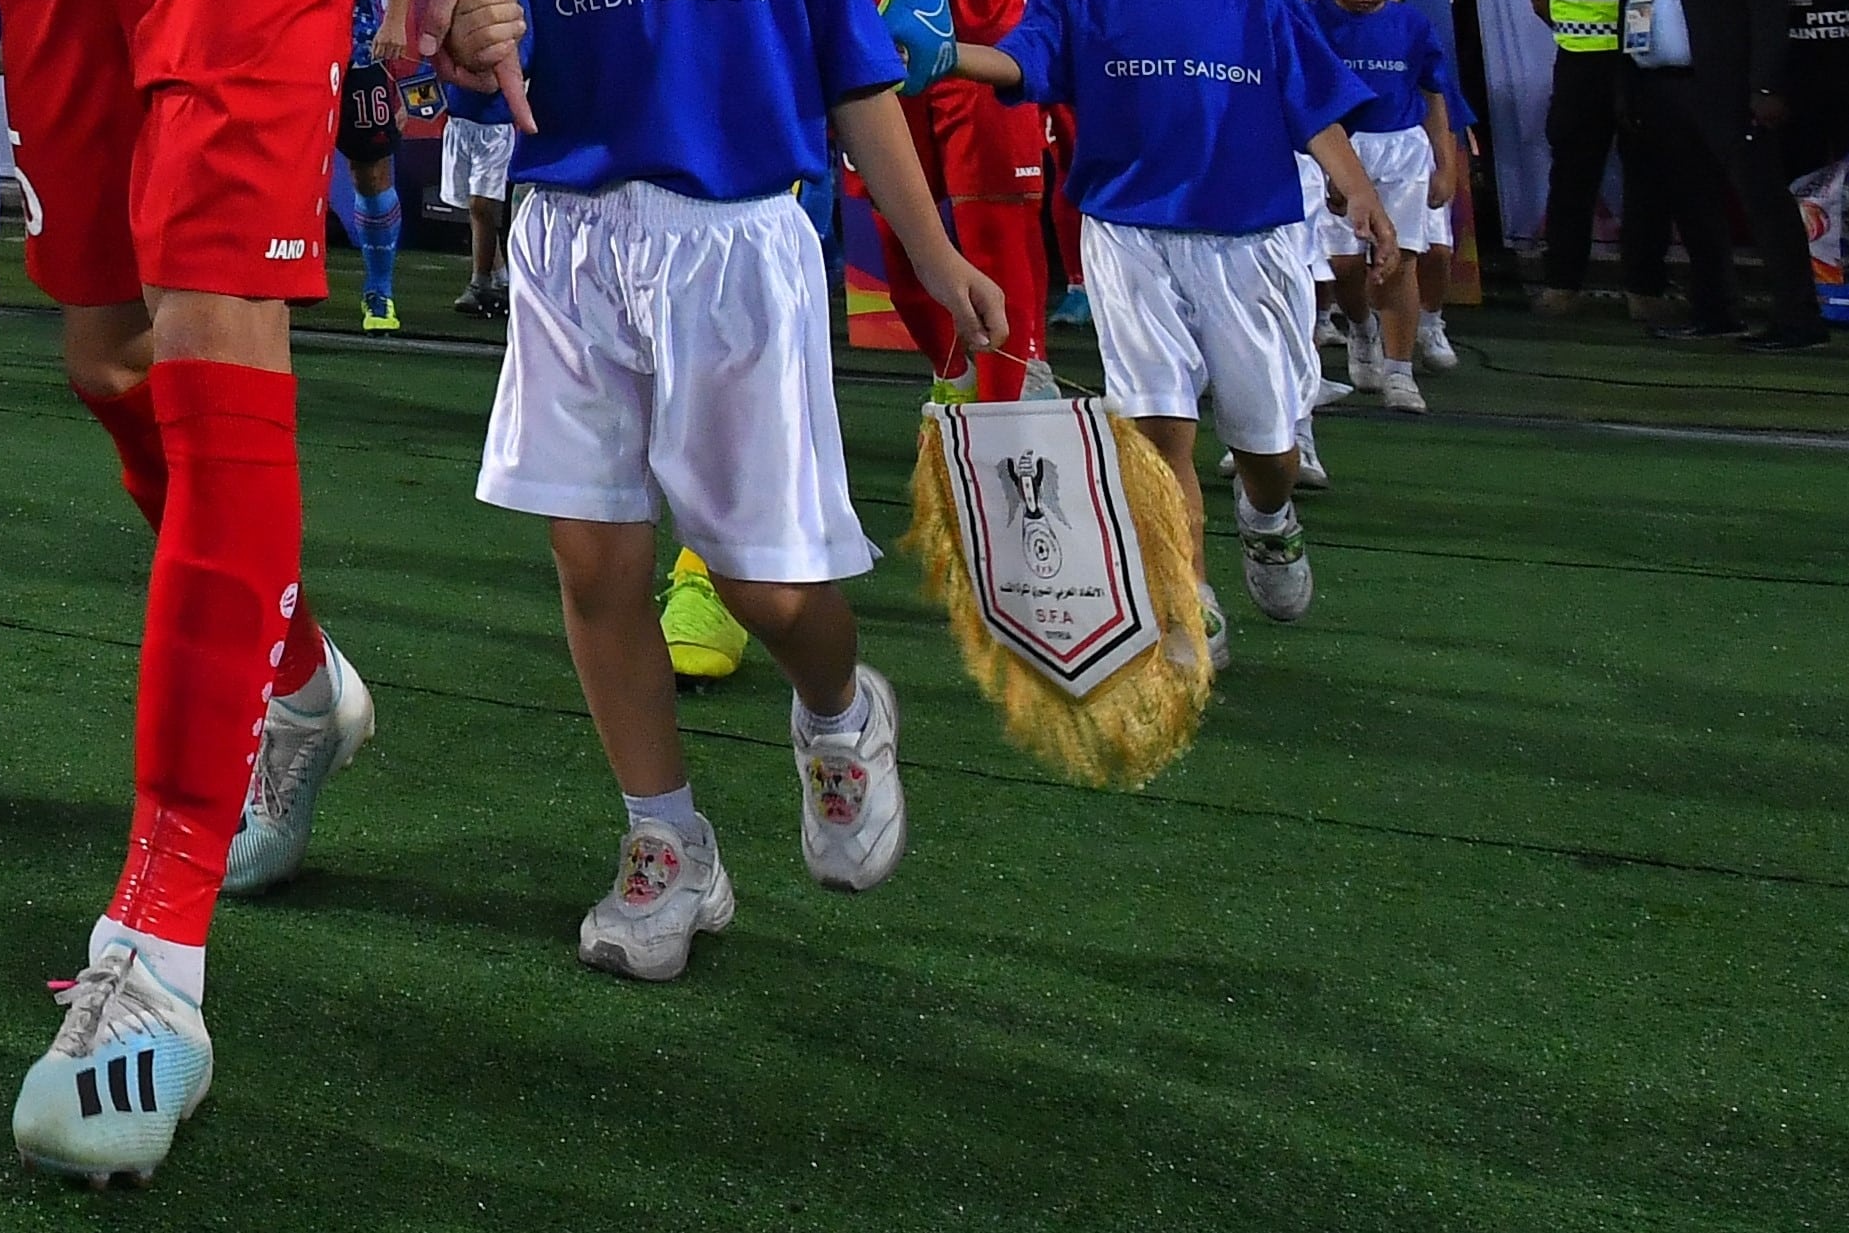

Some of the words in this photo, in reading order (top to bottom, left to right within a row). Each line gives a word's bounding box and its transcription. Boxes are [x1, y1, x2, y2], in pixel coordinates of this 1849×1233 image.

[1806, 10, 1849, 25] PITC
[1104, 60, 1177, 77] CREDIT
[1183, 59, 1261, 85] SAISON
[352, 86, 390, 129] 16
[265, 238, 305, 260] JAKO
